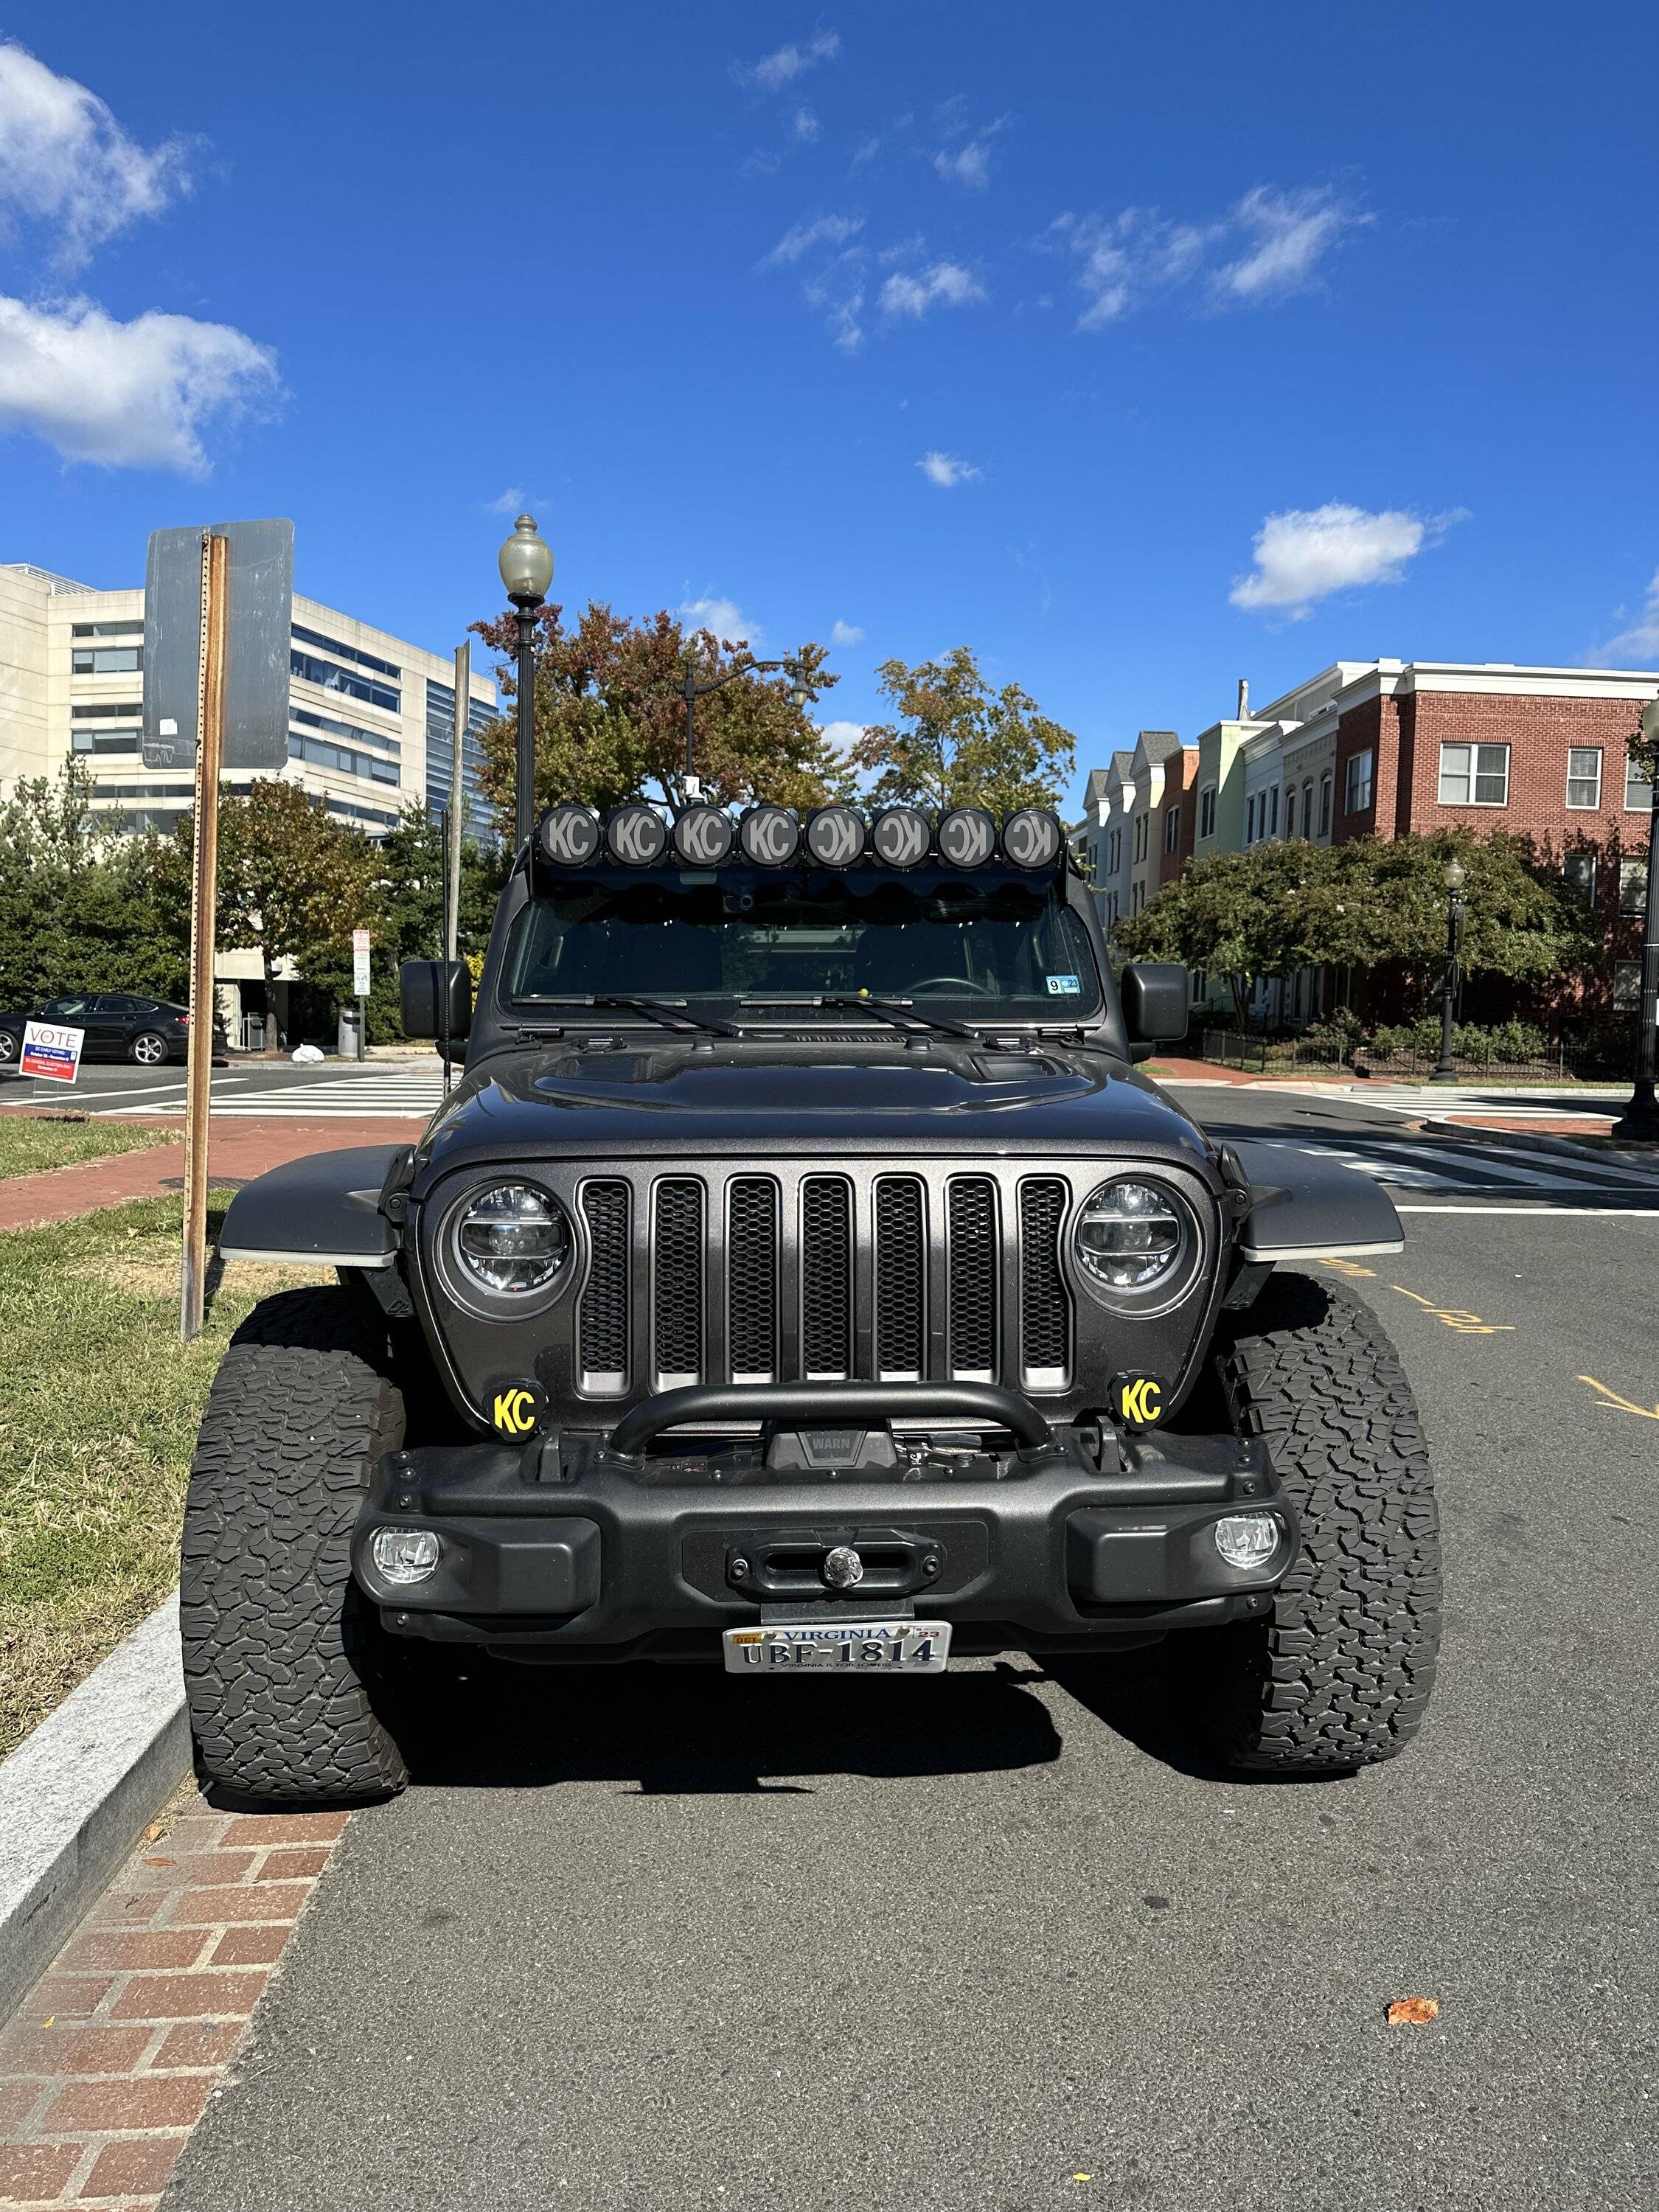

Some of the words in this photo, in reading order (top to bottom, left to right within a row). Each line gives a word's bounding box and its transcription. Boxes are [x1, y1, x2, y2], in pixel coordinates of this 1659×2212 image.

[549, 812, 588, 858] KC
[617, 813, 656, 859] KC
[684, 813, 723, 859] KC
[750, 813, 789, 860] KC
[817, 815, 856, 860] KC
[883, 815, 922, 860] KC
[948, 816, 987, 862] KC
[1013, 816, 1051, 862] KC
[1051, 981, 1058, 990] 9
[31, 1027, 77, 1048] VOTE
[494, 1389, 535, 1433] KC
[1122, 1379, 1161, 1423] KC
[813, 1438, 850, 1449] WARN
[740, 1638, 936, 1664] UBF-1814
[783, 1628, 891, 1641] VIRGINIA
